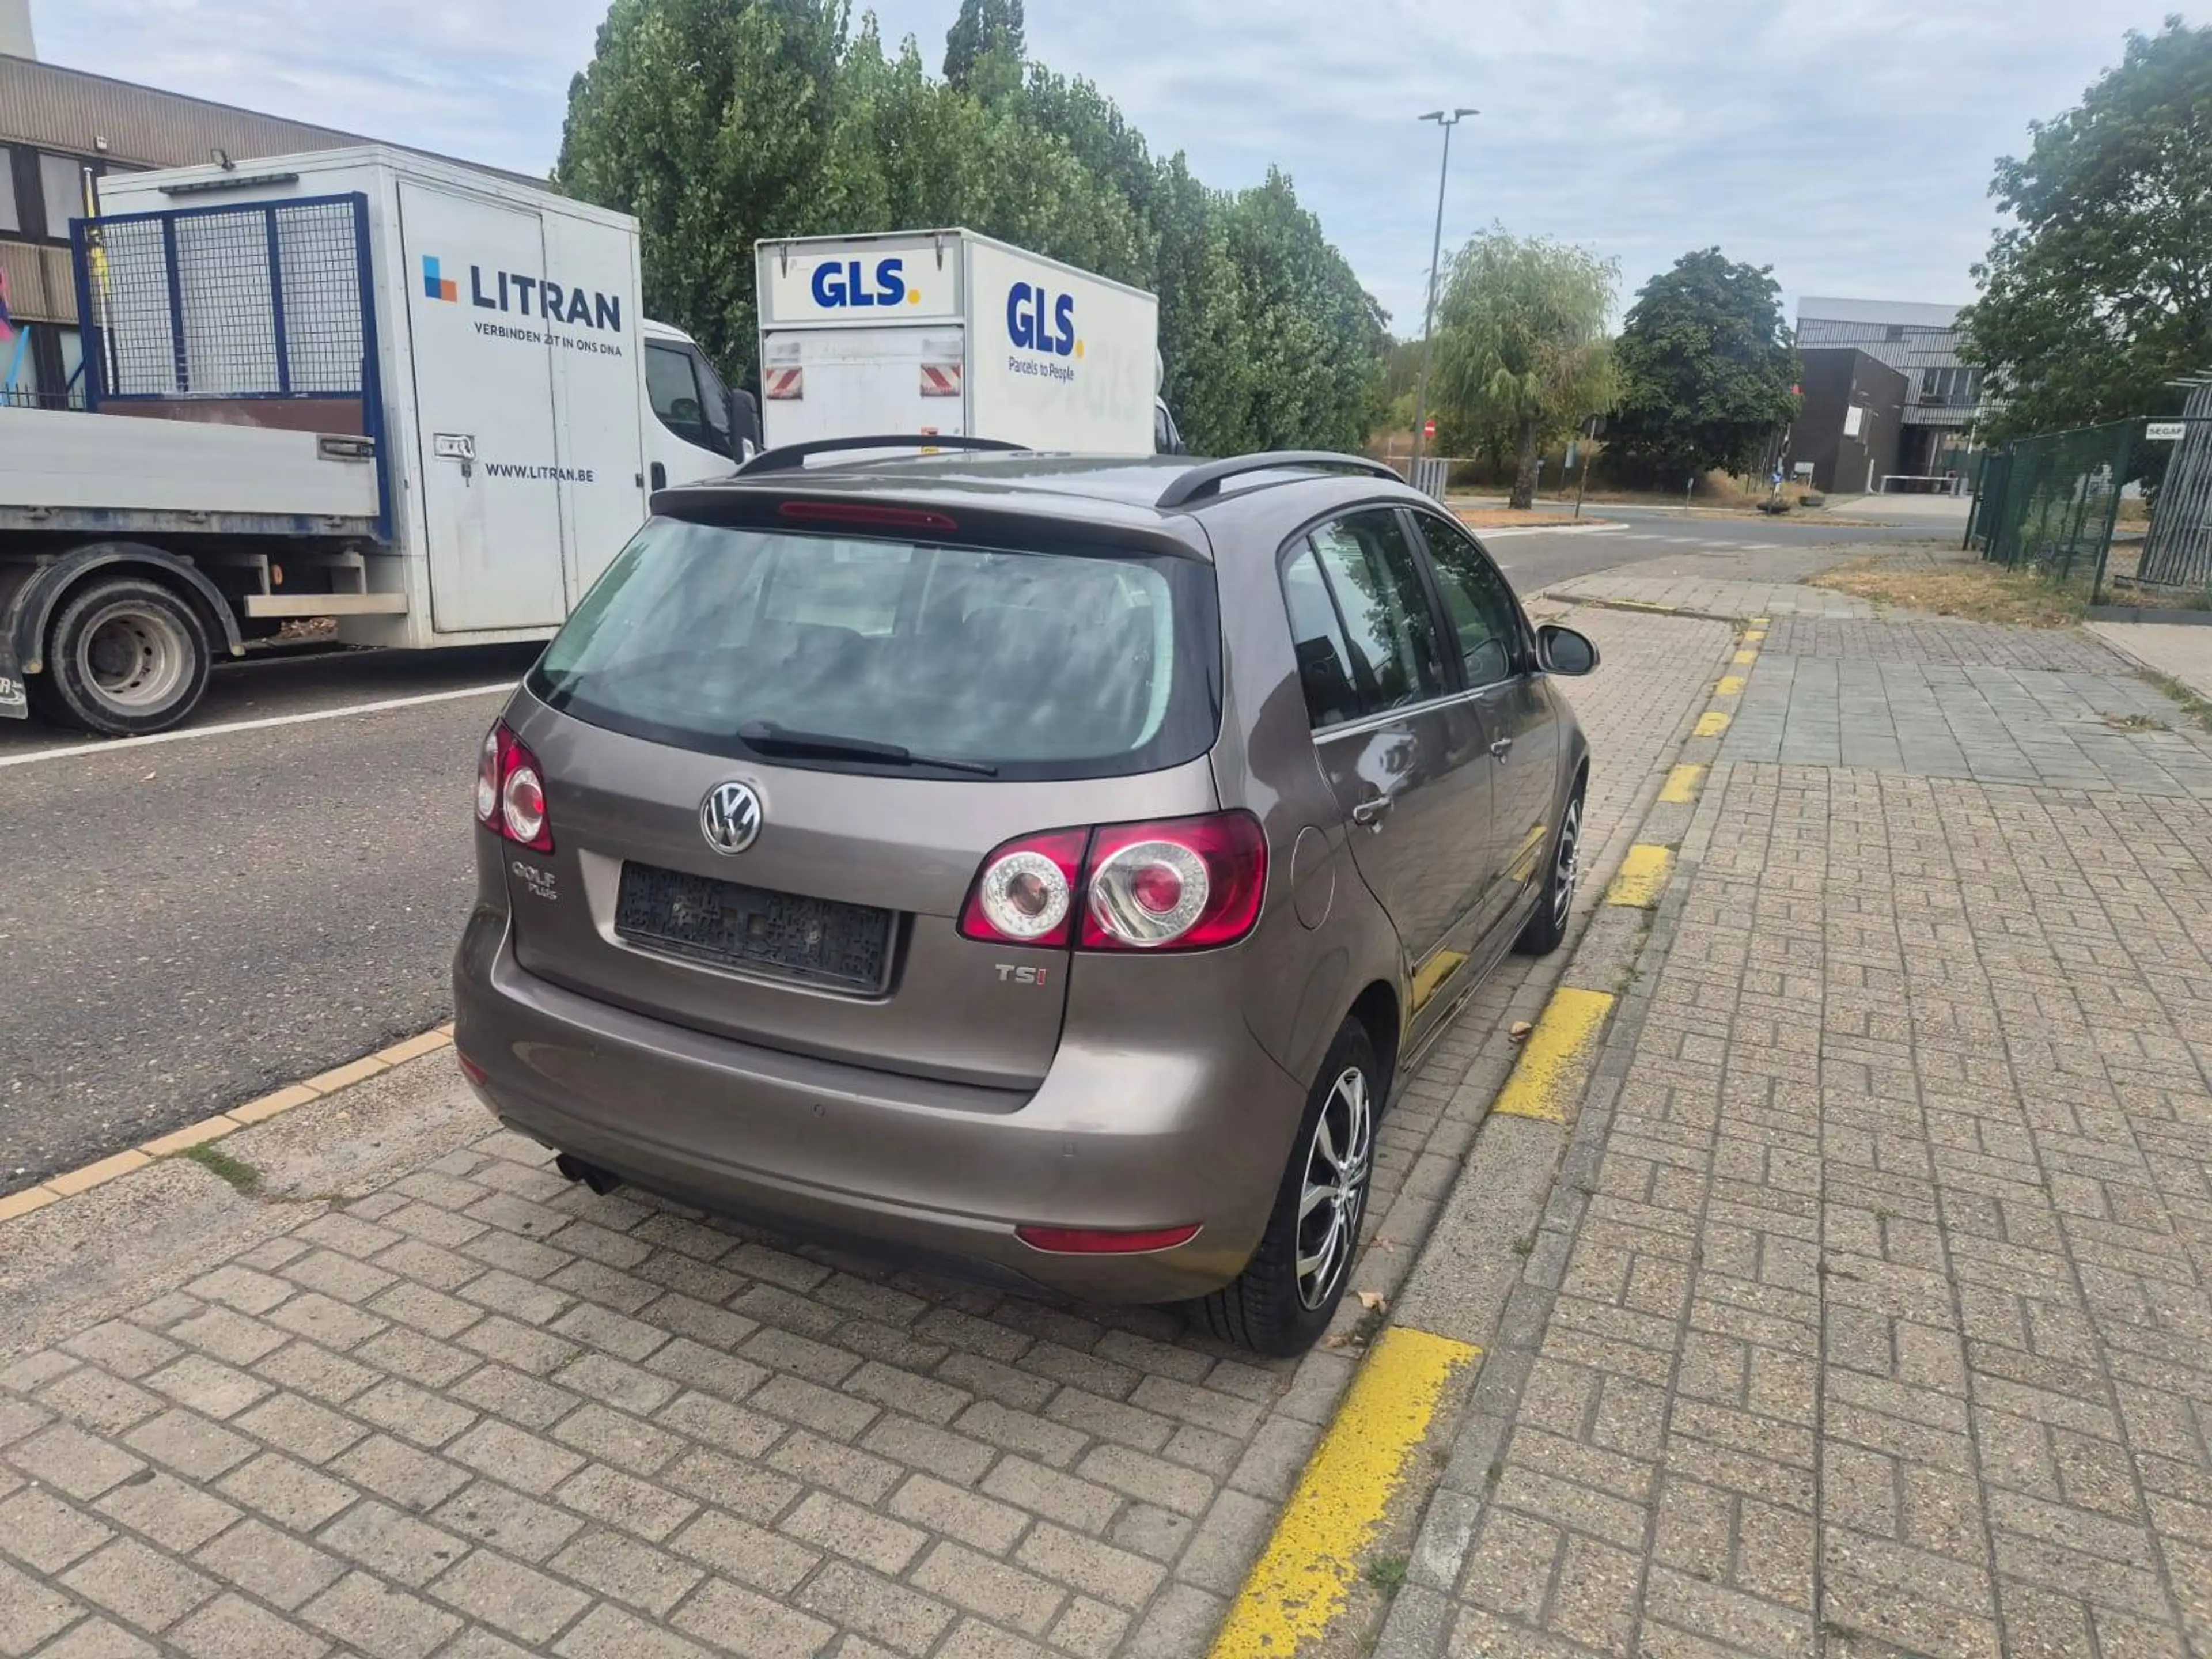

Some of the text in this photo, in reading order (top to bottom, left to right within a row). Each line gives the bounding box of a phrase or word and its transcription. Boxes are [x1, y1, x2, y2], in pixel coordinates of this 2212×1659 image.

[470, 265, 621, 332] LITRAN
[474, 321, 540, 343] VERBINDEN
[563, 338, 573, 349] IN
[577, 339, 597, 353] ONS
[600, 343, 622, 357] DNA
[1009, 356, 1075, 383] Parcels to People
[485, 463, 594, 482] WWW.LITRAN.BE
[512, 861, 556, 888] GOLF
[529, 882, 558, 900] PLUS
